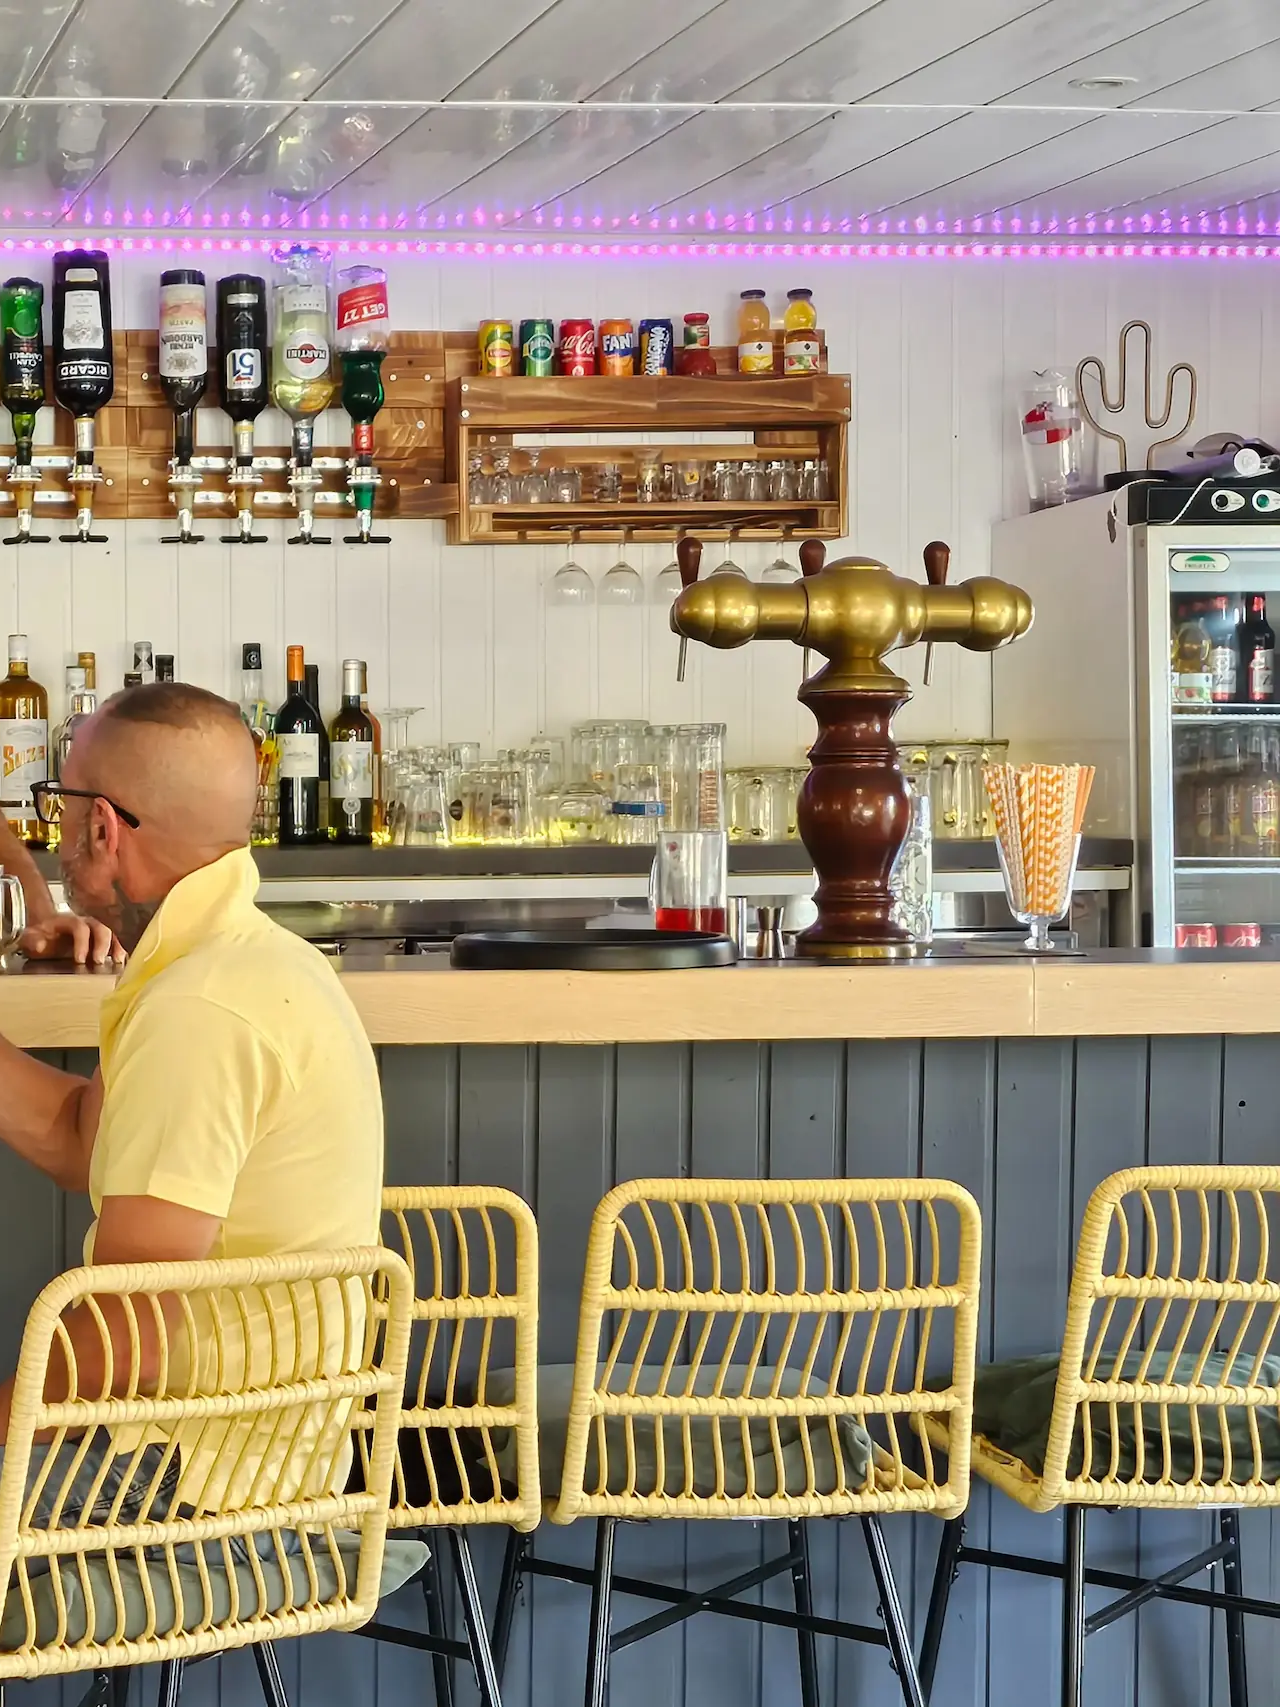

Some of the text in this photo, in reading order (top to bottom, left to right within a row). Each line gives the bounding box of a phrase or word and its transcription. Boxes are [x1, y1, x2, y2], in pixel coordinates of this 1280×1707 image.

[343, 303, 386, 324] GET 27
[603, 333, 633, 351] FAN
[287, 349, 326, 358] MARTINI
[16, 359, 37, 367] CLAN
[60, 364, 108, 376] RICARD
[232, 352, 255, 378] 51
